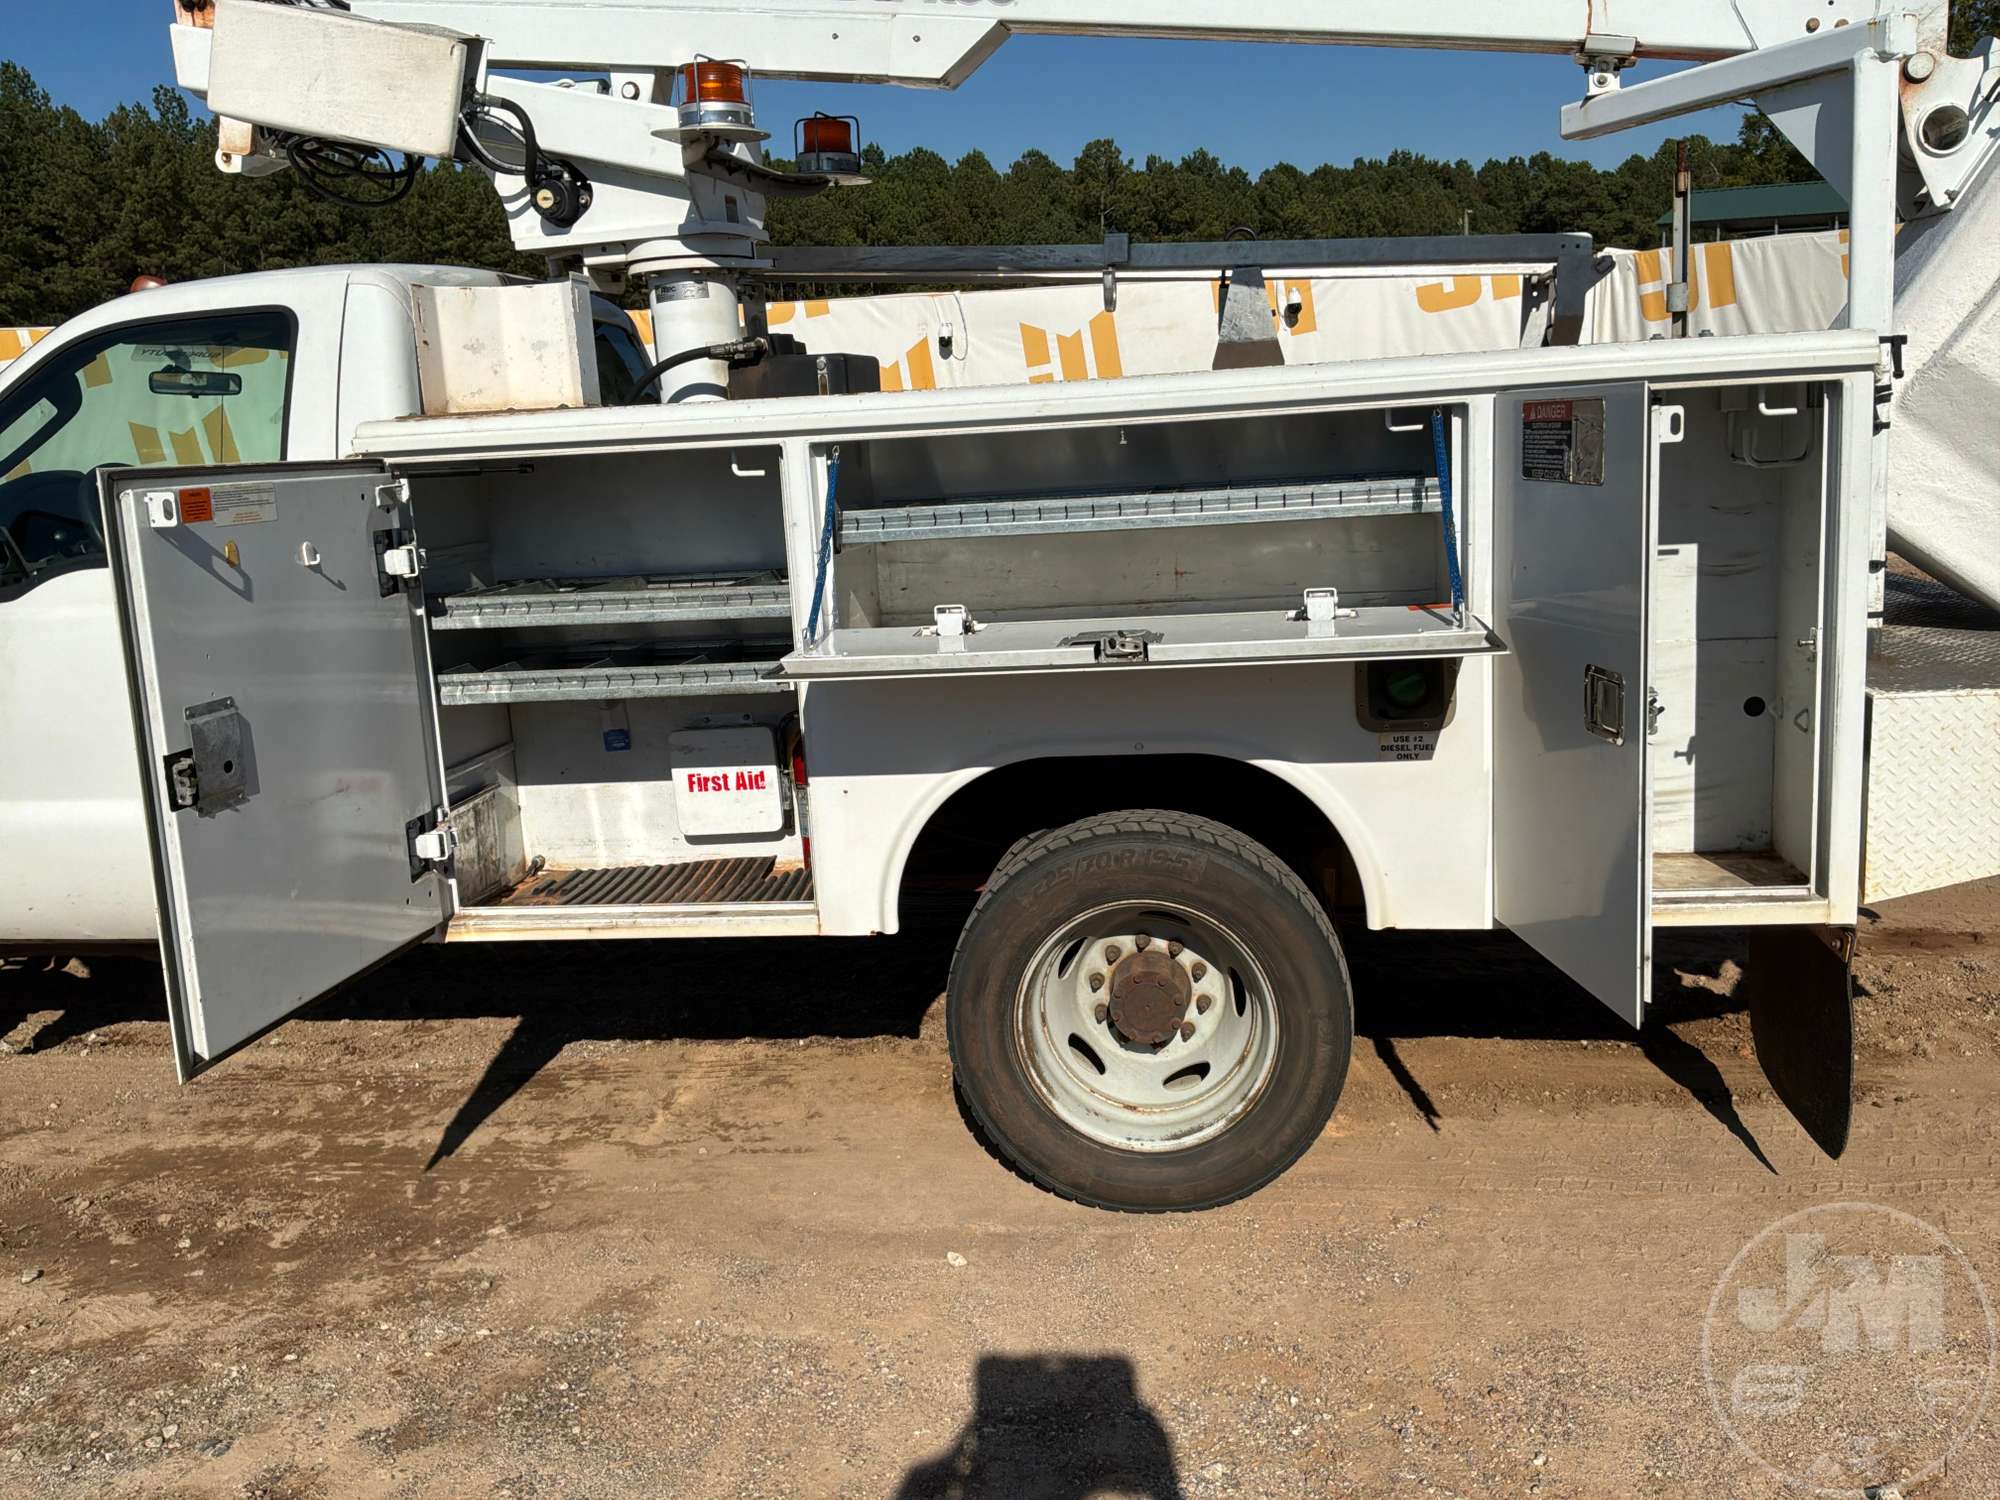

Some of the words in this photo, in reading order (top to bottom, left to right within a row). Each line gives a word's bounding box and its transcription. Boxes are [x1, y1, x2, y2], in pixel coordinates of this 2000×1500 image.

[1536, 404, 1566, 418] DANGER
[1392, 735, 1410, 743] USE
[1380, 744, 1411, 752] DIESEL
[1413, 743, 1435, 751] FUEL
[1396, 752, 1420, 760] ONLY
[687, 773, 730, 792] First
[735, 770, 766, 791] Aid
